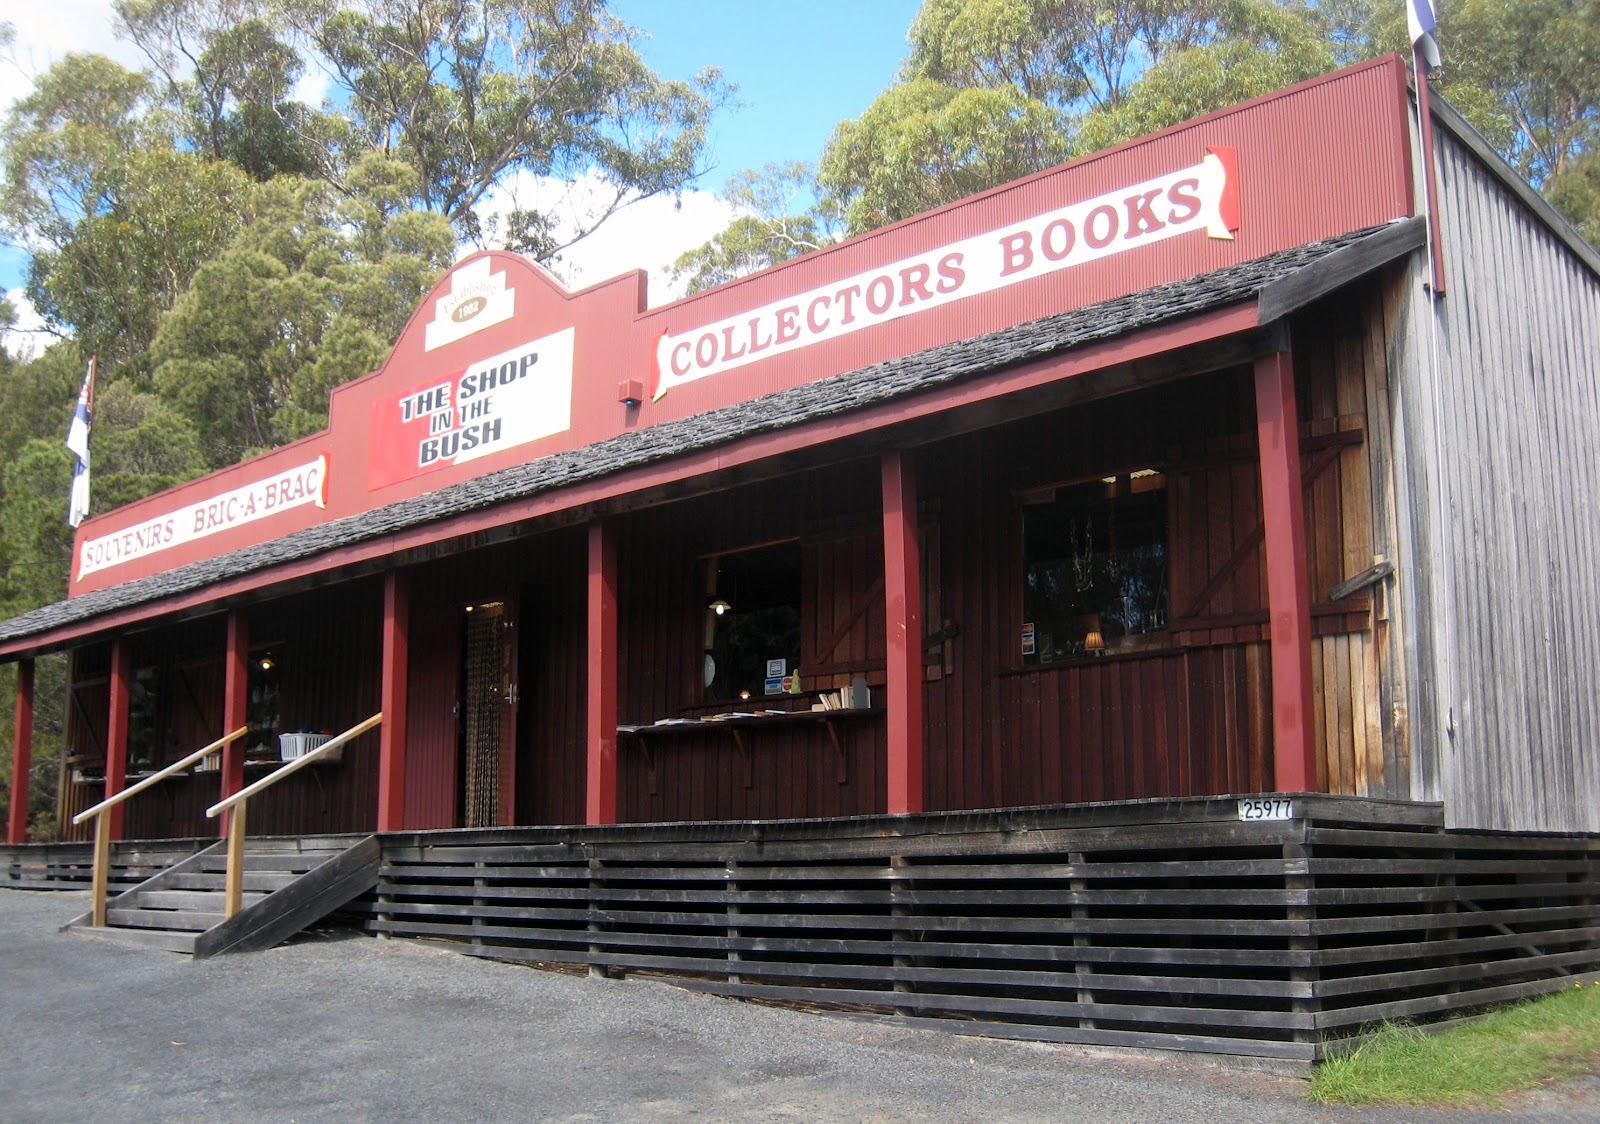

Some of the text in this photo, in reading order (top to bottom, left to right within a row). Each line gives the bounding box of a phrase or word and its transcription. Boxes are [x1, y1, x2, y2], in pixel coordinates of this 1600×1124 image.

[670, 178, 1202, 377] COLLECTORS BOOKS
[458, 300, 480, 319] 1982
[402, 352, 538, 420] THE SHOP
[432, 395, 493, 433] IN THE
[420, 417, 502, 464] BUSH
[85, 518, 174, 568] SOUVENIRS
[1243, 800, 1291, 819] 25977
